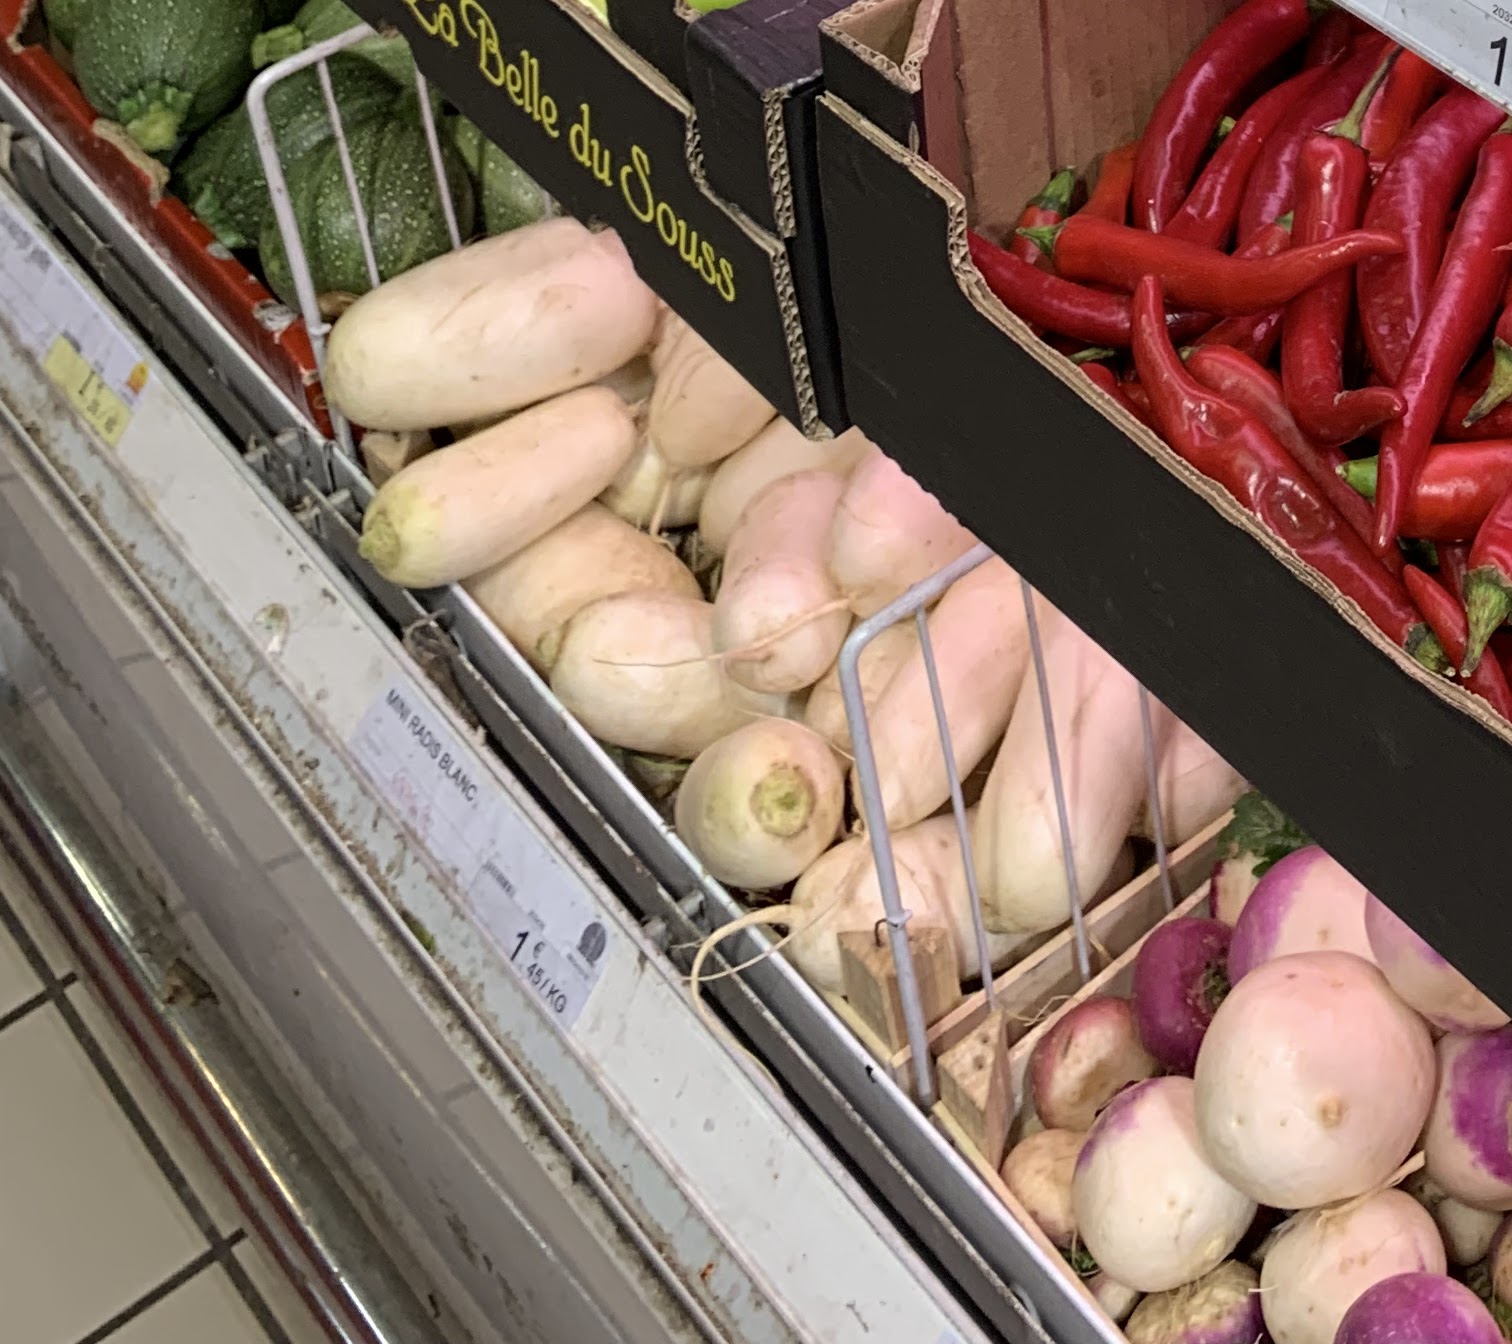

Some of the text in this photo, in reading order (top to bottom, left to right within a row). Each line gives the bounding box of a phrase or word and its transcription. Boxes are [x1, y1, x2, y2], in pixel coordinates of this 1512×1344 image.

[568, 103, 613, 187] du
[620, 145, 736, 303] Souss
[438, 752, 478, 802] BLANC
